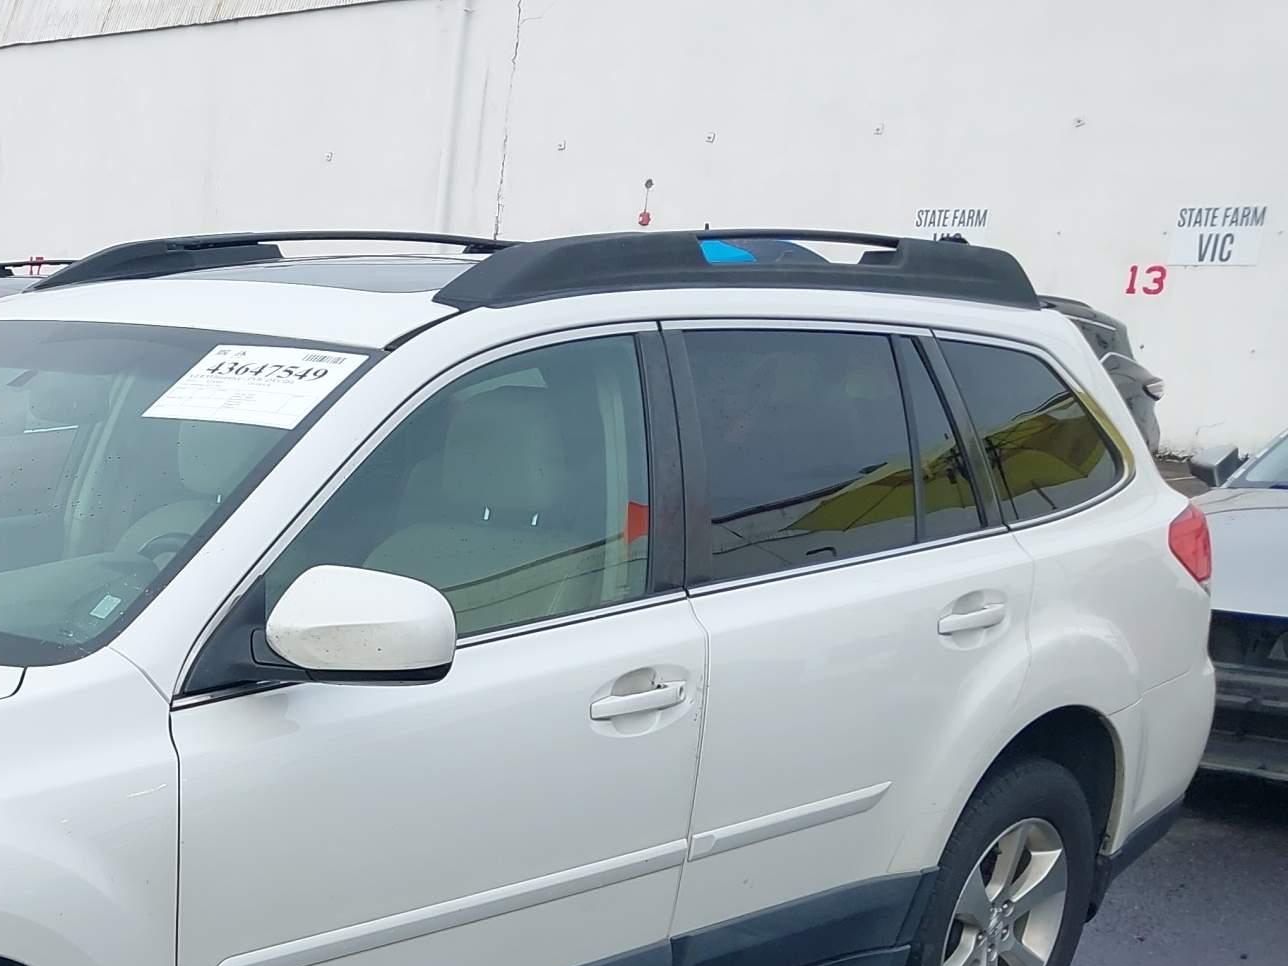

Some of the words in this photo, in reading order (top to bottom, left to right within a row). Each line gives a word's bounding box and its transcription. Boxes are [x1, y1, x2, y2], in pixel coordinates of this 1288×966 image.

[915, 209, 950, 228] STATE
[952, 209, 988, 228] FARM
[1177, 207, 1219, 228] STATE
[1222, 206, 1267, 227] FARM
[1197, 232, 1235, 263] VIC
[1125, 265, 1168, 295] 13
[206, 361, 329, 381] 43647549
